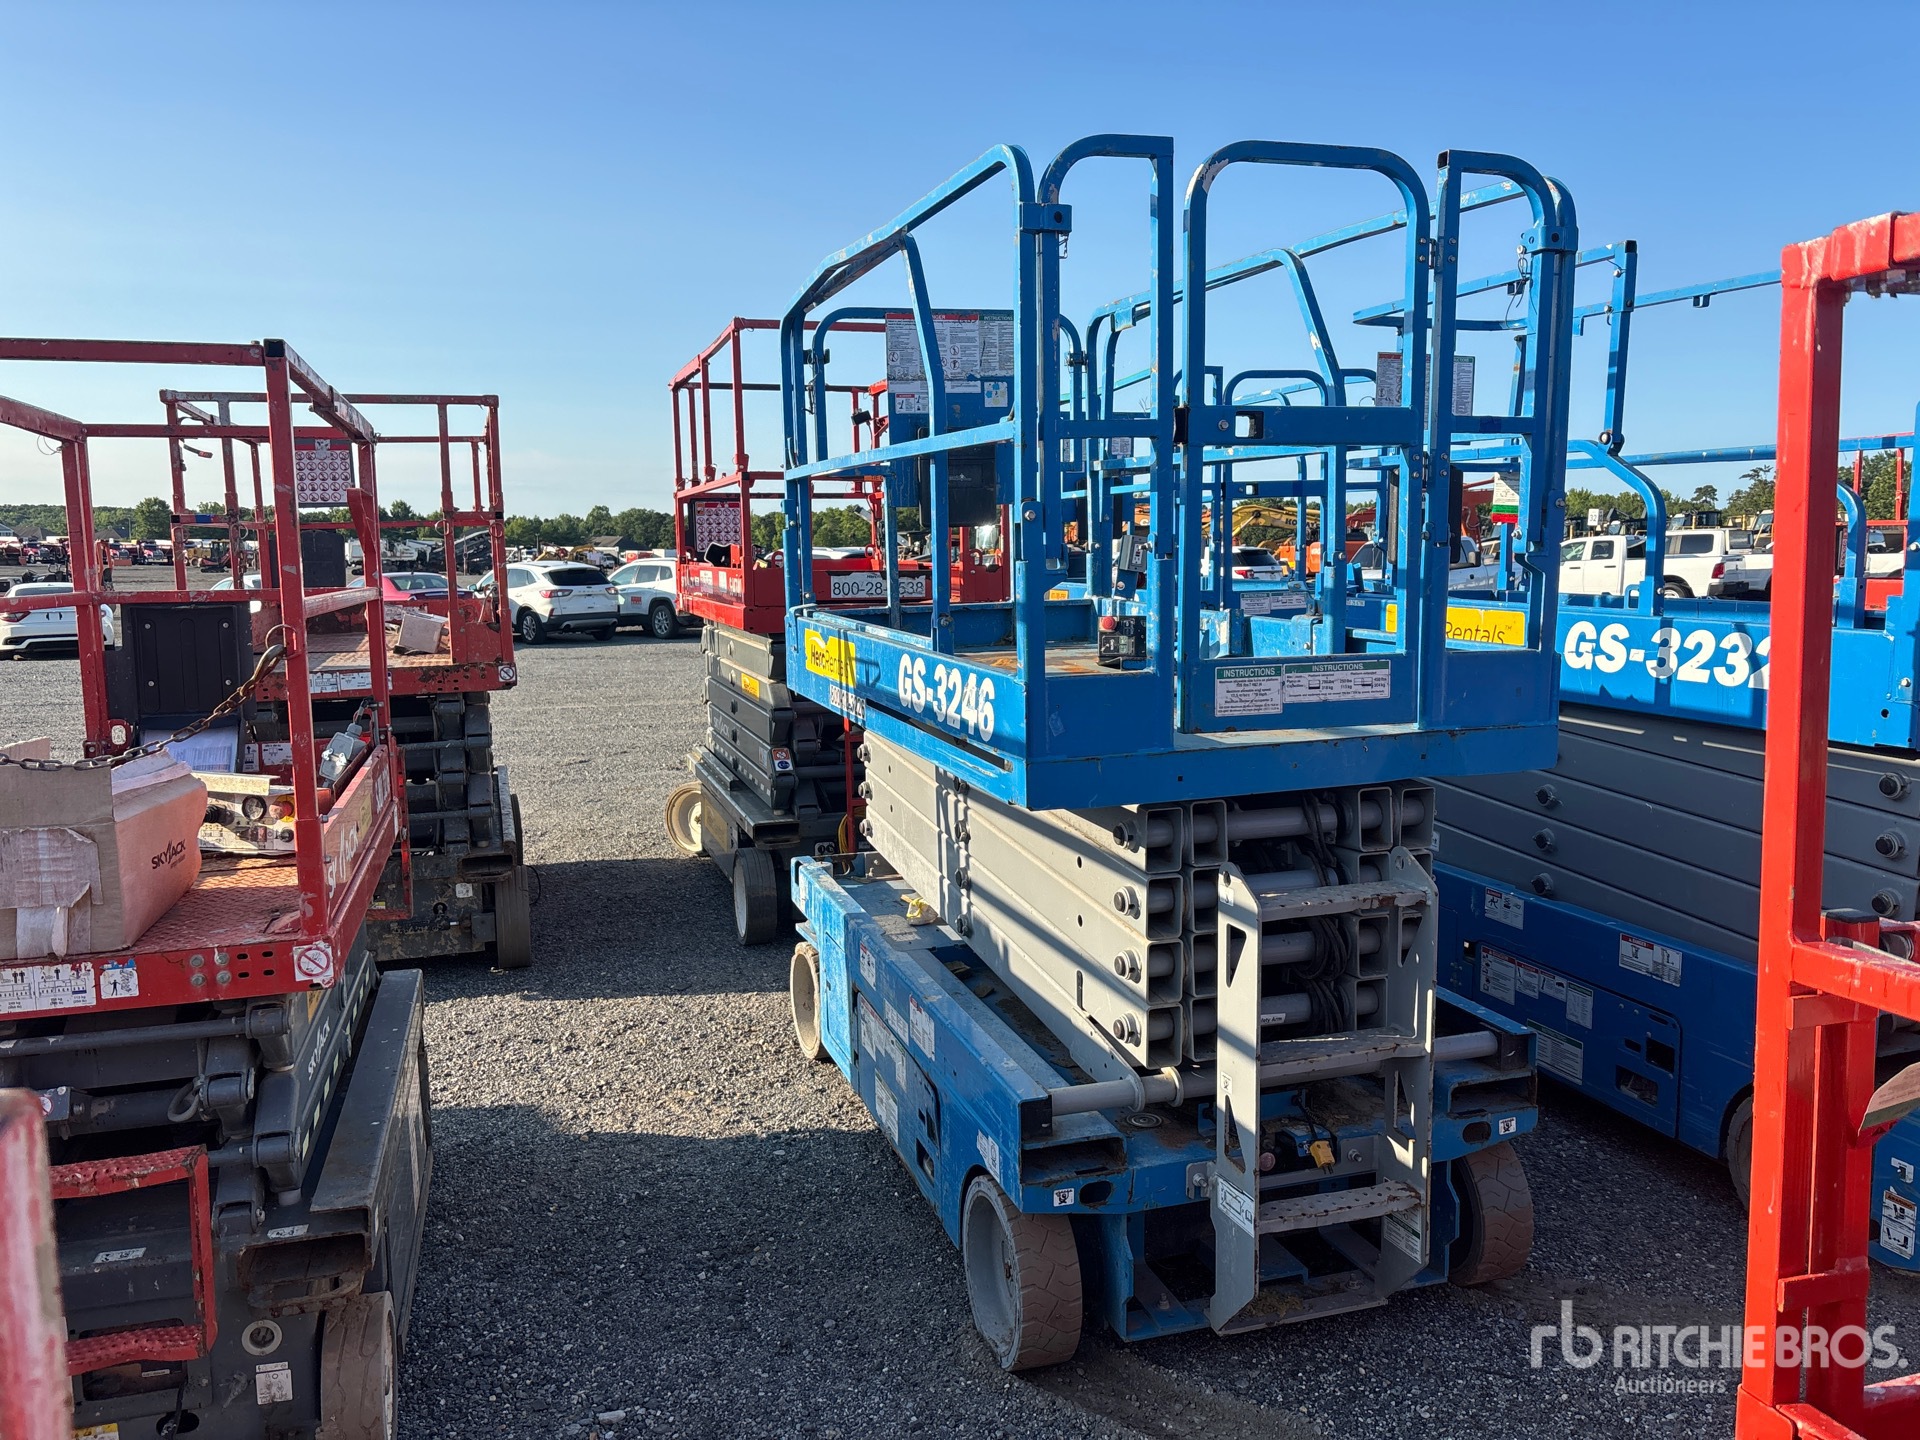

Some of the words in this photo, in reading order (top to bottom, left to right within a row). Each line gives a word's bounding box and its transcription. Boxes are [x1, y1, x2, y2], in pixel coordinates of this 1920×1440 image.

[1223, 667, 1276, 678] INSTRUCTIONS
[1312, 663, 1364, 672] INSTRUCTIONS
[899, 653, 995, 742] GS-3246
[151, 839, 186, 869] SKYJACK
